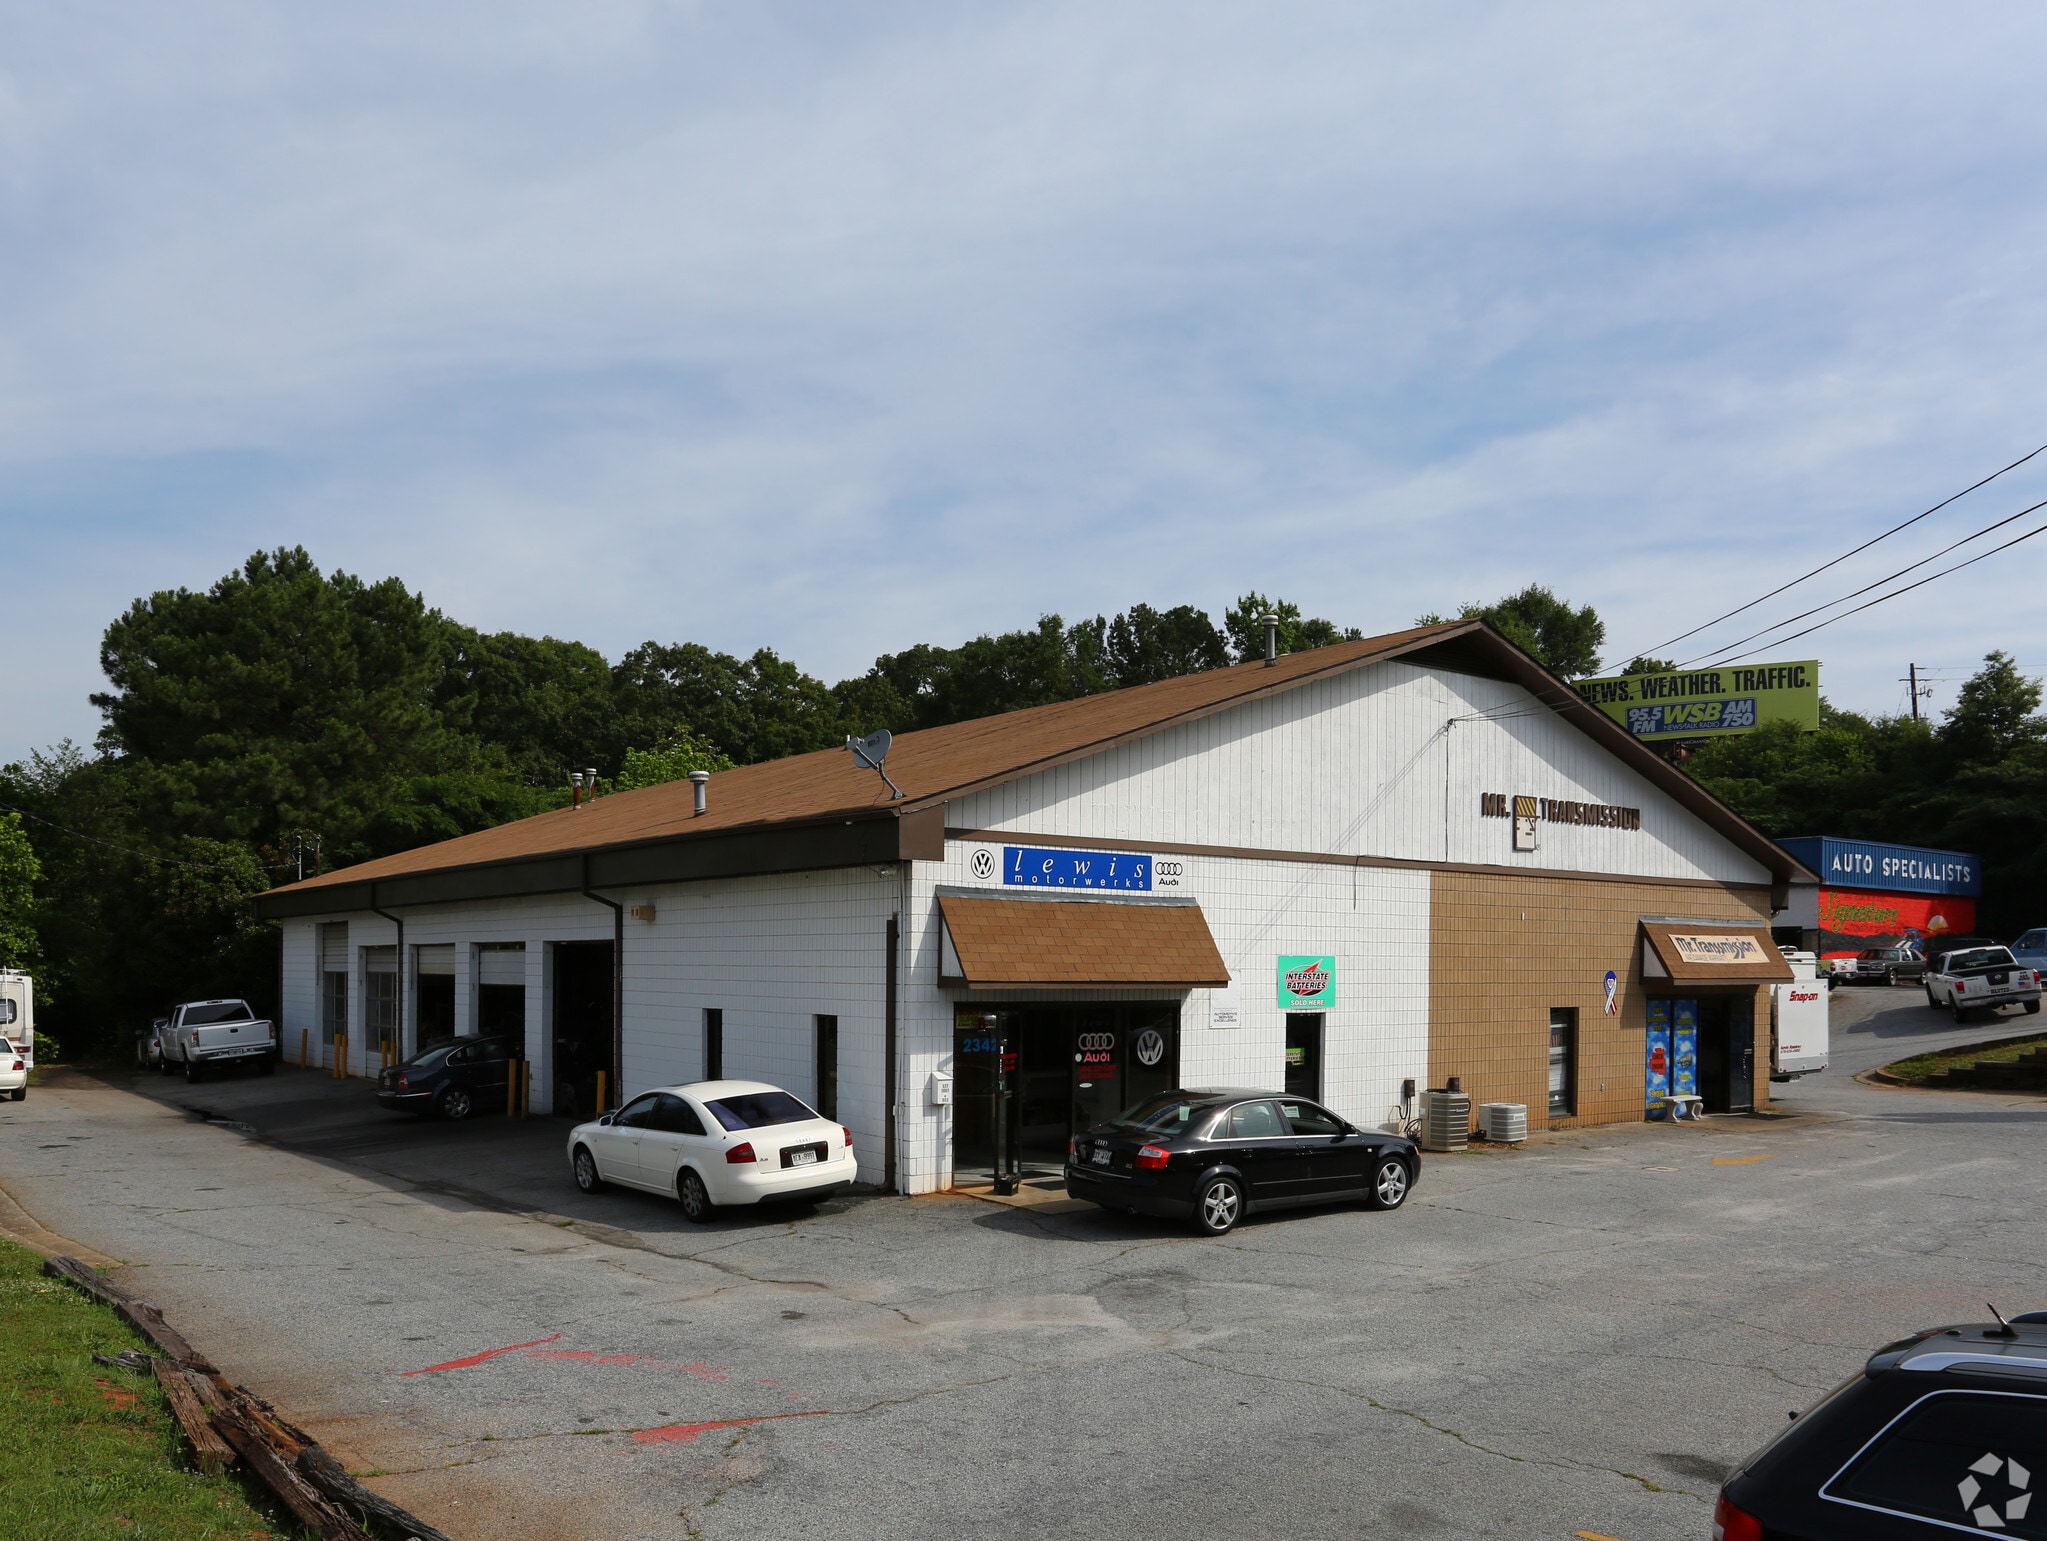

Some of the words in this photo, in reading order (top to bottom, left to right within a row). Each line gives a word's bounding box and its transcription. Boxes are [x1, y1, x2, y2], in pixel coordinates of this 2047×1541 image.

[1579, 681, 1634, 703] NEWS.
[1641, 672, 1726, 700] WEATHER.
[1732, 665, 1811, 692] TRAFFIC.
[1628, 705, 1663, 722] 95.5
[1663, 702, 1723, 725] WSB
[1724, 701, 1752, 715] AM
[1632, 719, 1656, 734] FM
[1700, 720, 1719, 729] RADIO
[1722, 713, 1754, 728] 750
[1482, 792, 1511, 818] MR.
[1540, 797, 1641, 832] TRANSMISSION
[1014, 850, 1144, 879] lewis
[1832, 853, 1873, 874] AUTO
[1882, 857, 1971, 883] SPECIALISTS
[1015, 874, 1144, 889] motorwerks
[1158, 878, 1179, 886] Audi
[1819, 890, 1898, 932] Signature
[1285, 972, 1329, 980] INTERSTATE
[1789, 990, 1818, 1003] Snap-on
[1083, 1051, 1111, 1063] Audi
